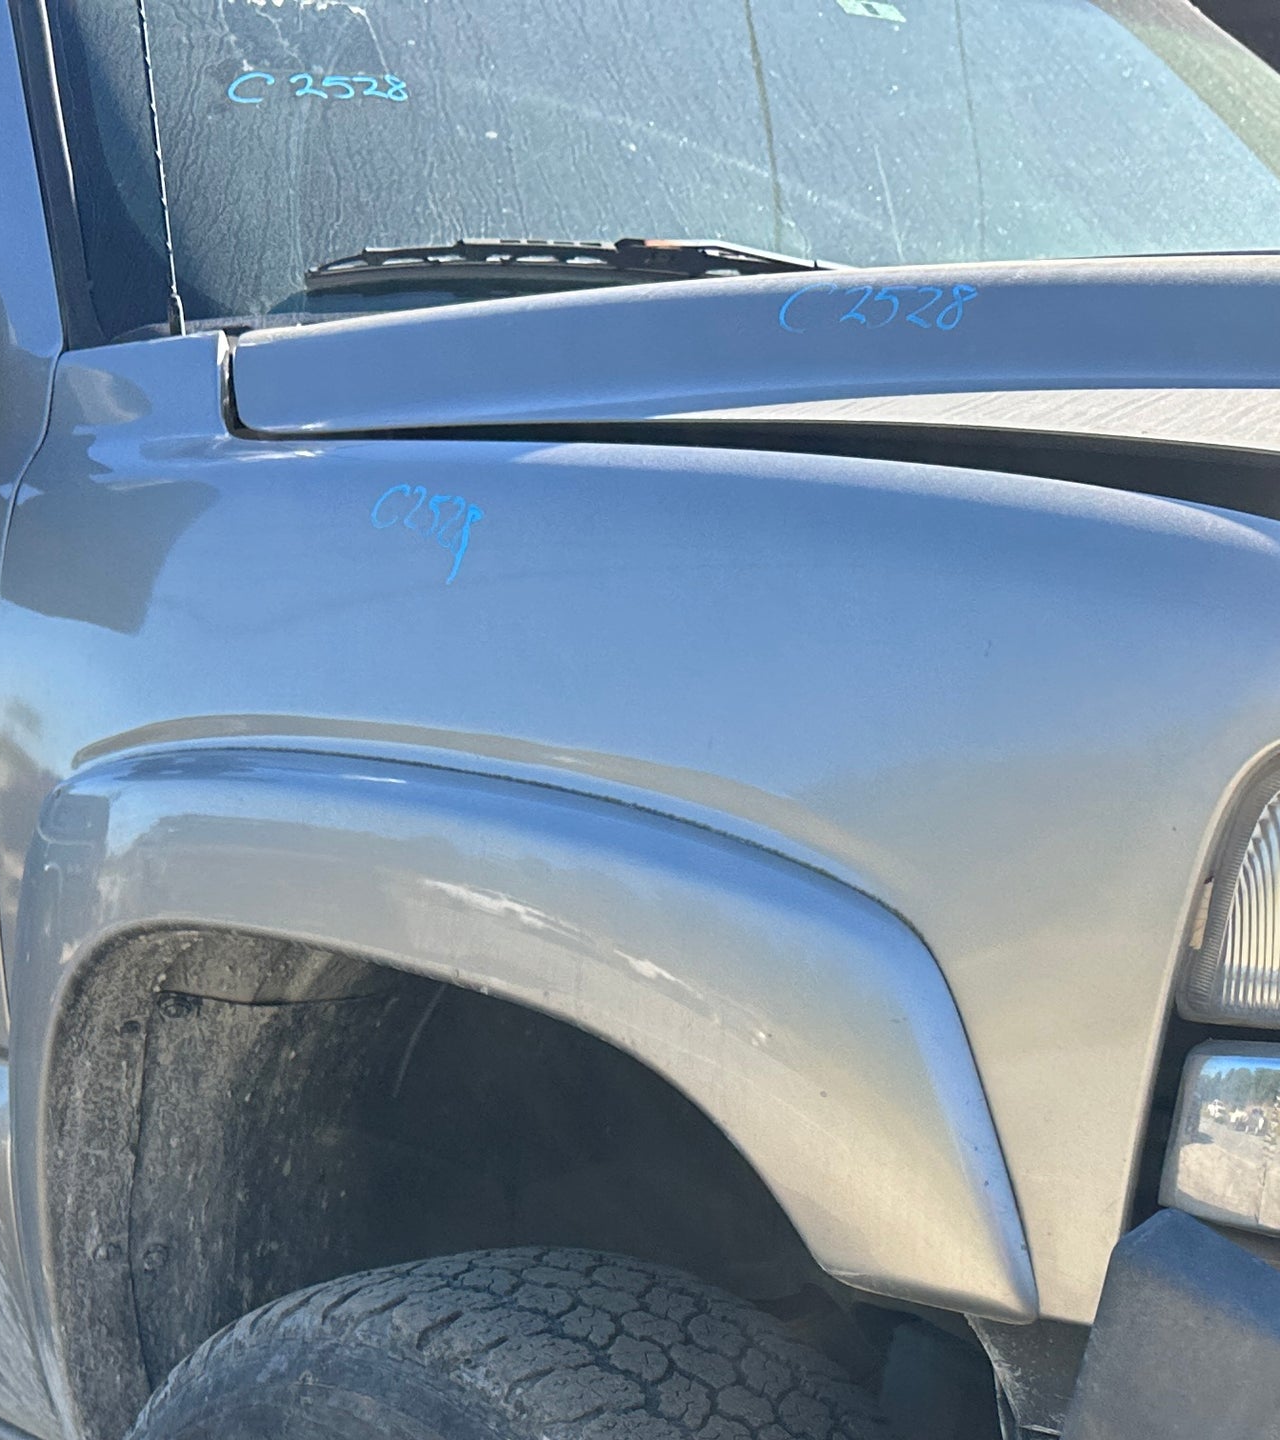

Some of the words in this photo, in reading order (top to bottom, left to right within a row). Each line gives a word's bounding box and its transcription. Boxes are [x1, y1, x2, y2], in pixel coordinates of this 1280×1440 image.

[227, 71, 275, 103] C
[289, 72, 408, 101] 2528
[778, 282, 838, 334] C
[839, 283, 978, 331] 2528
